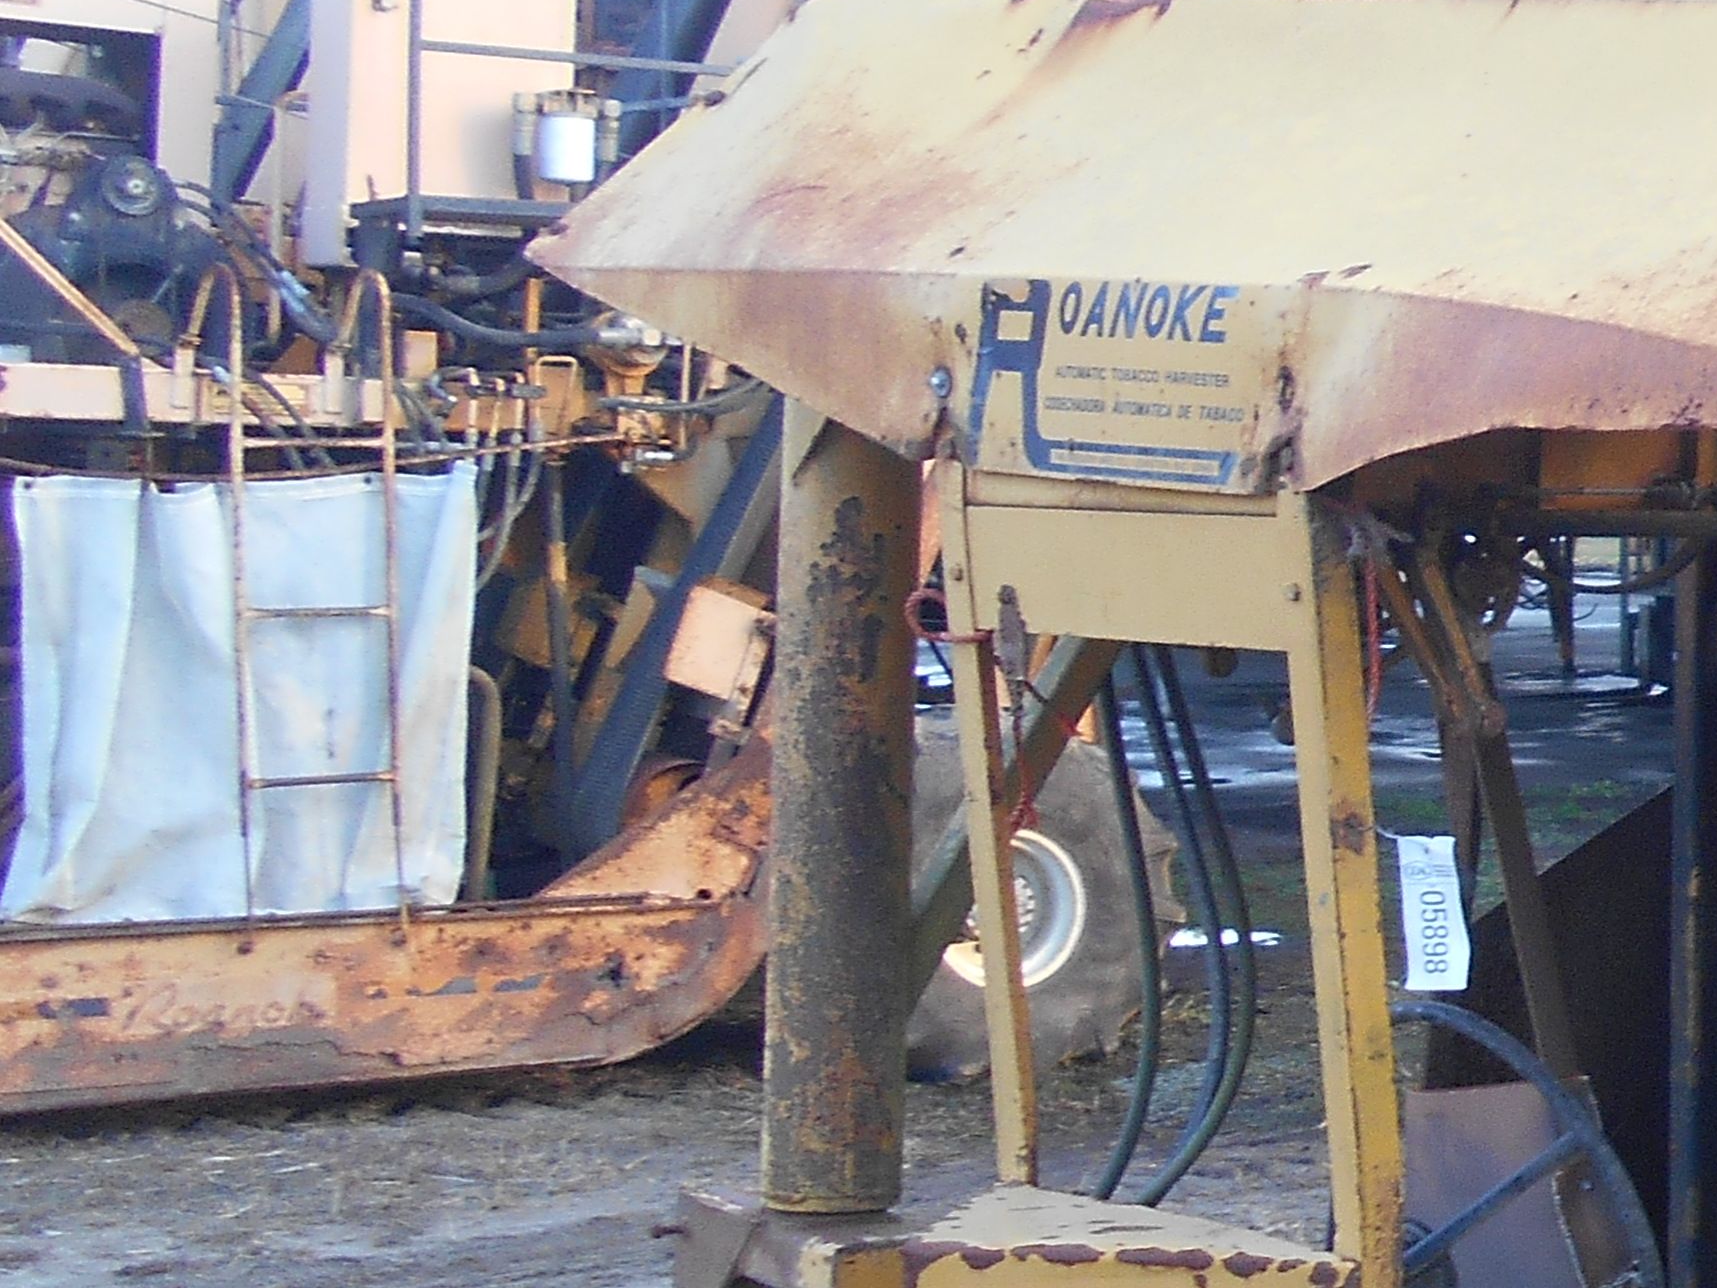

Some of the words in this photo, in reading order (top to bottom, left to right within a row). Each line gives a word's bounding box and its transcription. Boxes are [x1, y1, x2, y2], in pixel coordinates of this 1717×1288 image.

[1056, 365, 1107, 381] AUTOMATIC
[1111, 367, 1160, 383] TOBACCO
[1165, 370, 1230, 387] HARVESTER
[1419, 890, 1449, 974] 05898
